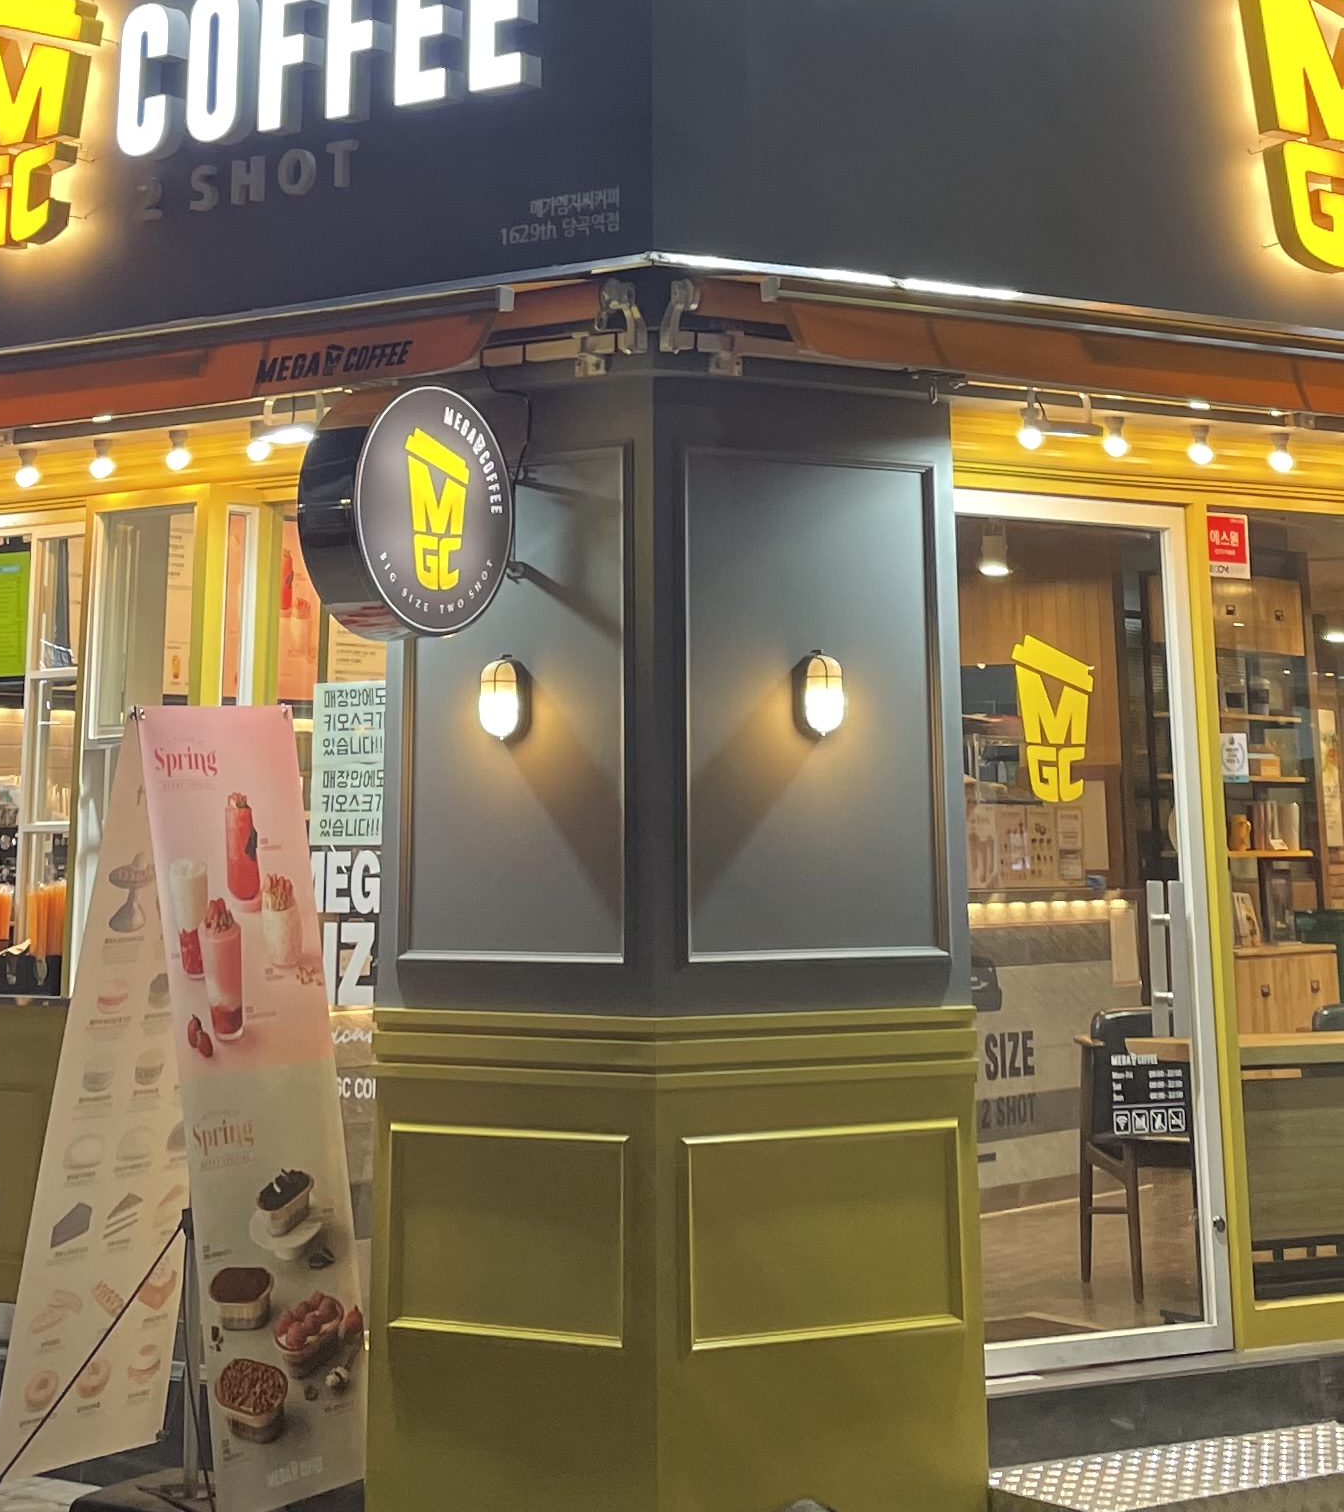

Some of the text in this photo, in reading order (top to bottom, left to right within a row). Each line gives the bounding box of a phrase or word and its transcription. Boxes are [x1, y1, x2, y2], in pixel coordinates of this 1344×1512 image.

[189, 139, 360, 210] SHOT
[499, 211, 620, 245] 1629th 당곡역점
[256, 354, 320, 384] MEGA
[343, 340, 414, 372] COFFEE
[443, 406, 503, 515] MEGA COFFEE
[378, 551, 494, 615] BIG SIZE TWO SHOT
[323, 687, 386, 708] 매장안에도
[154, 746, 218, 778] Spring
[322, 736, 383, 757] 있습니다!!
[322, 769, 384, 789] 매장안에도
[319, 817, 380, 838] 있습니다!!
[984, 1030, 1036, 1081] SIZE
[980, 1092, 1037, 1130] 2 SHOT
[192, 1118, 255, 1156] Spring
